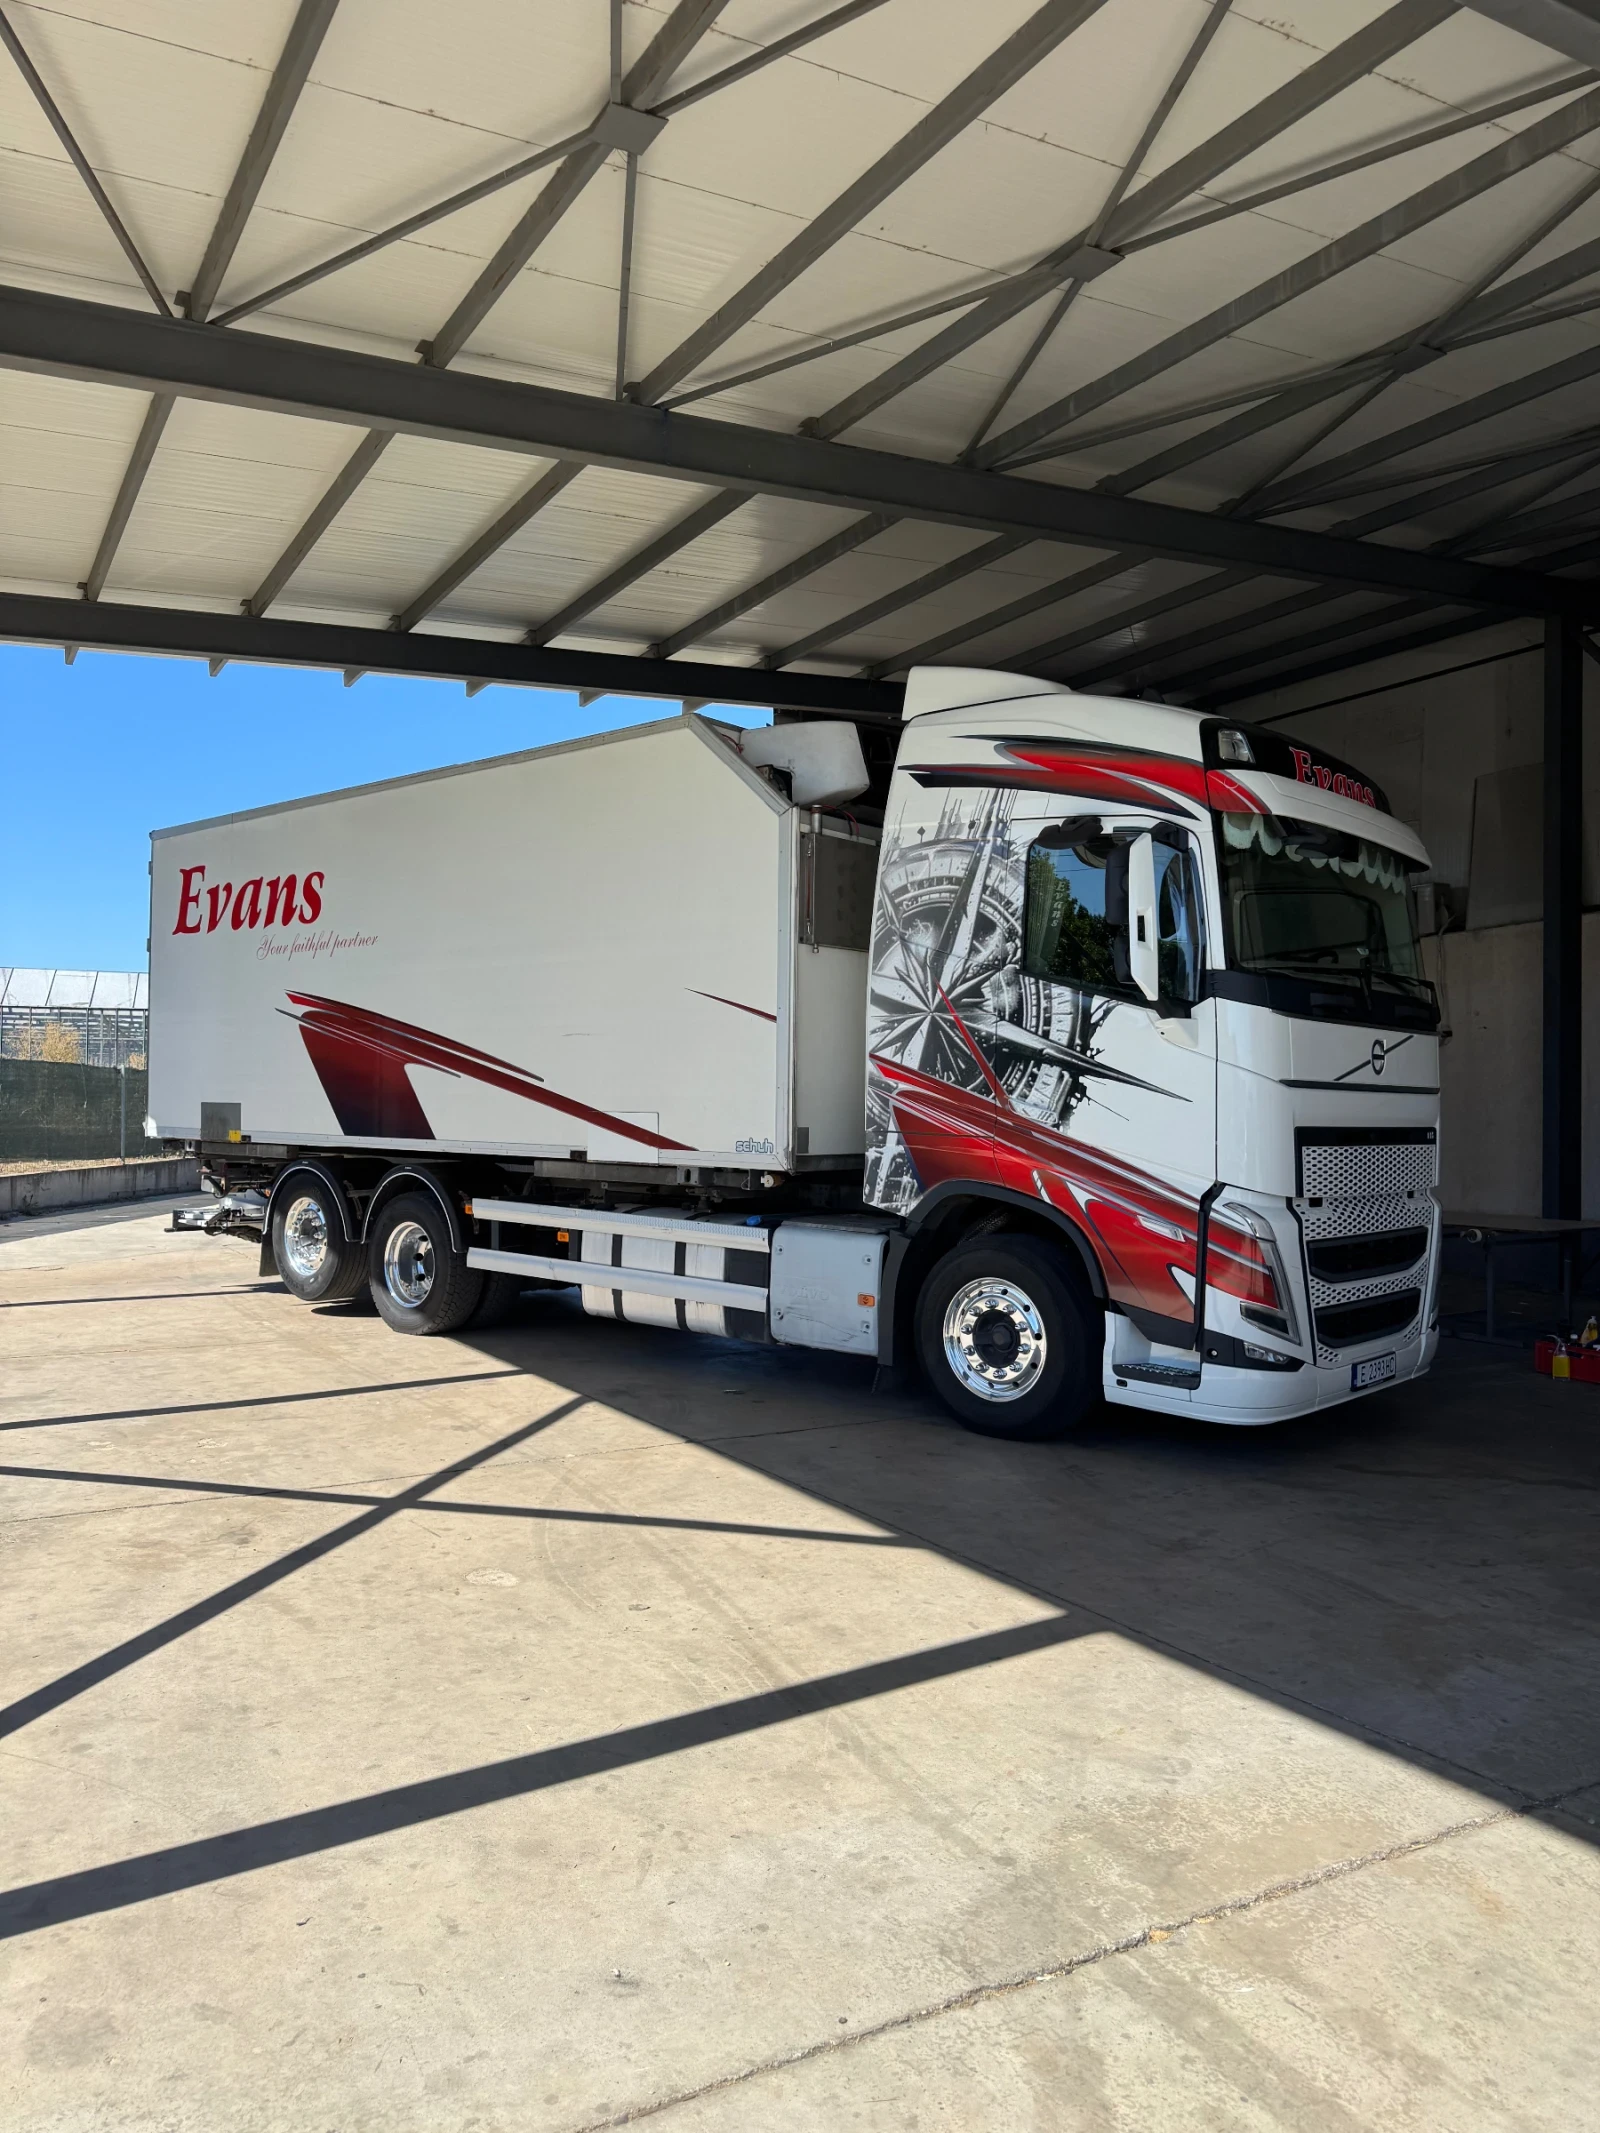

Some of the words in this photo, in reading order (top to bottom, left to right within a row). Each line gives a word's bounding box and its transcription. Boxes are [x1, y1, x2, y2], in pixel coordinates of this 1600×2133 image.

[1288, 746, 1376, 808] Evans
[172, 865, 325, 935] Evans
[1051, 881, 1067, 927] Evans
[256, 934, 289, 960] Your
[288, 931, 334, 961] faithful
[330, 931, 378, 957] partner
[736, 1137, 774, 1153] schuh
